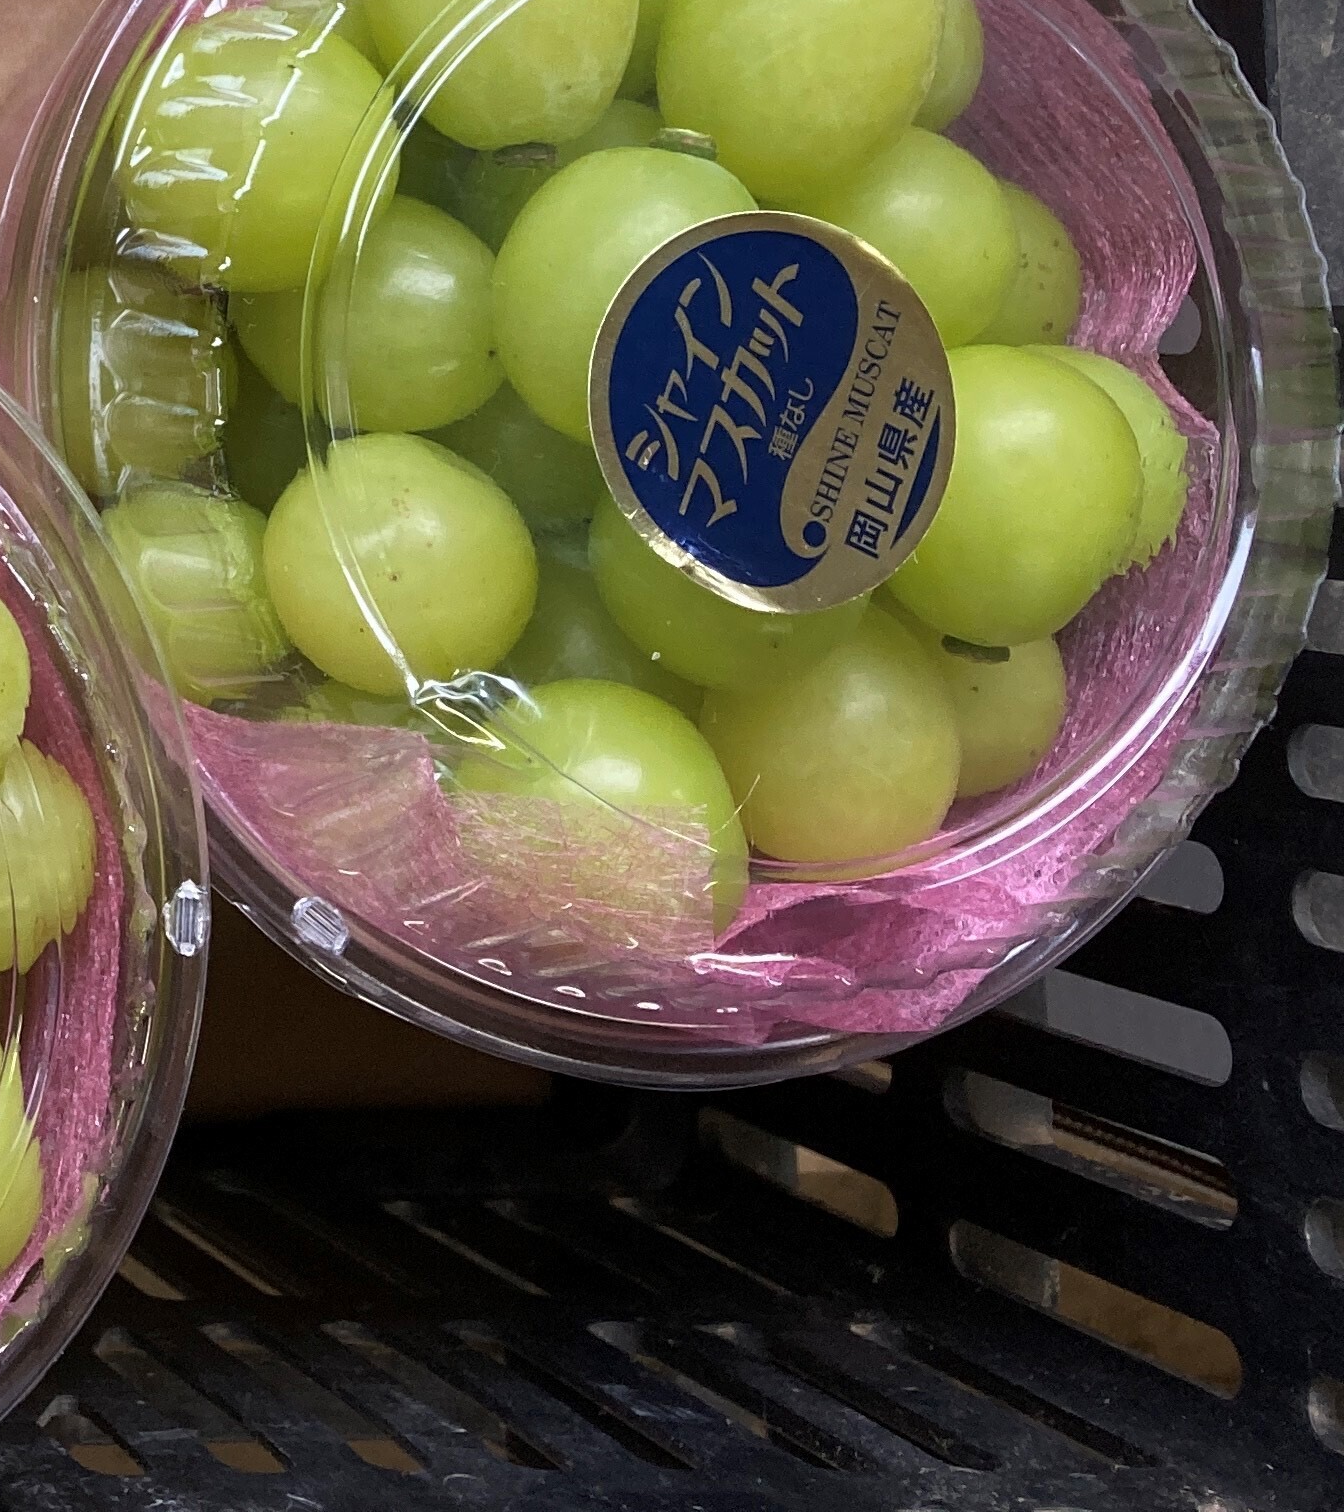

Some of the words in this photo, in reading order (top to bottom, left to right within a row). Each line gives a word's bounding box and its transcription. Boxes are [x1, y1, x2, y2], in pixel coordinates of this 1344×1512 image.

[625, 251, 733, 481] シャイン
[678, 263, 805, 527] マスカット
[767, 377, 814, 461] 種なし
[812, 427, 859, 523] SHINE
[844, 300, 902, 429] MUSCAT
[843, 375, 935, 559] 岡山県産
